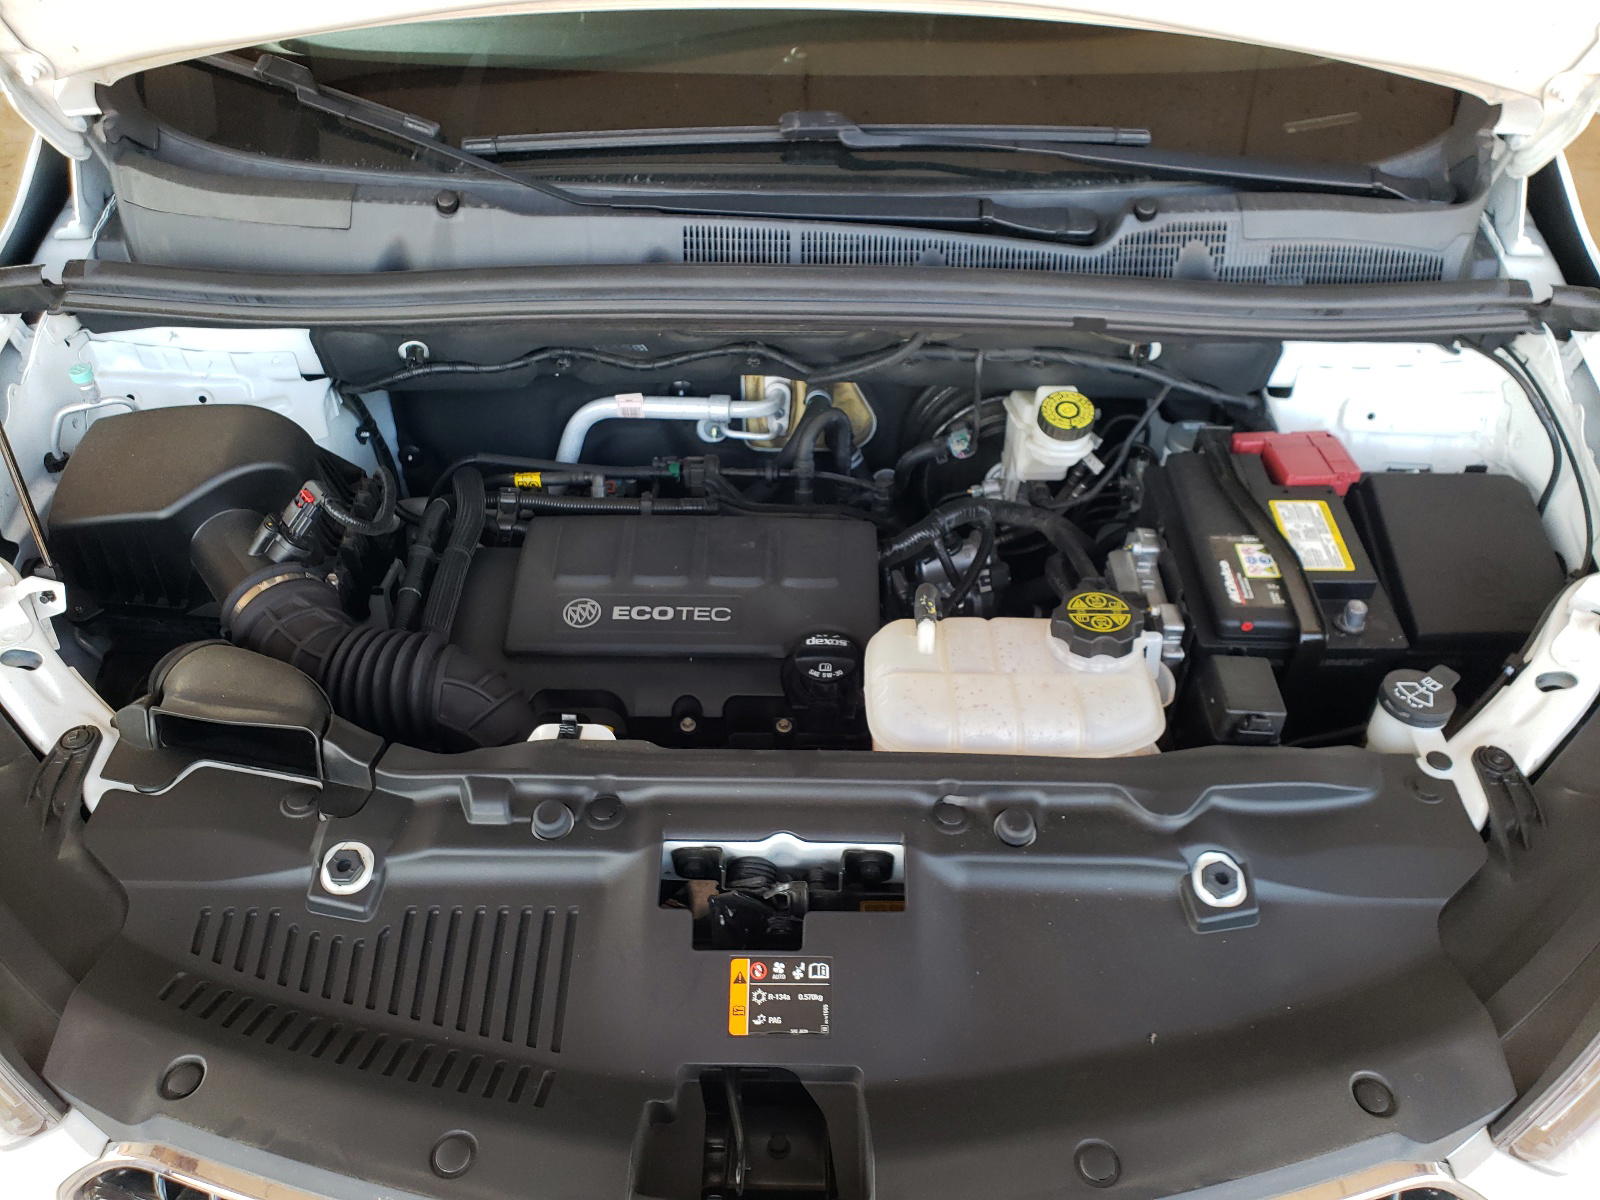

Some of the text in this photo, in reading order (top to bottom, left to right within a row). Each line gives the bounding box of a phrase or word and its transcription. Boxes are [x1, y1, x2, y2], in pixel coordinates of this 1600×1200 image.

[612, 606, 731, 621] ECOTEC
[805, 637, 848, 646] dexos
[767, 993, 824, 1002] R-134a 0.570kg
[768, 1016, 782, 1024] PAG
